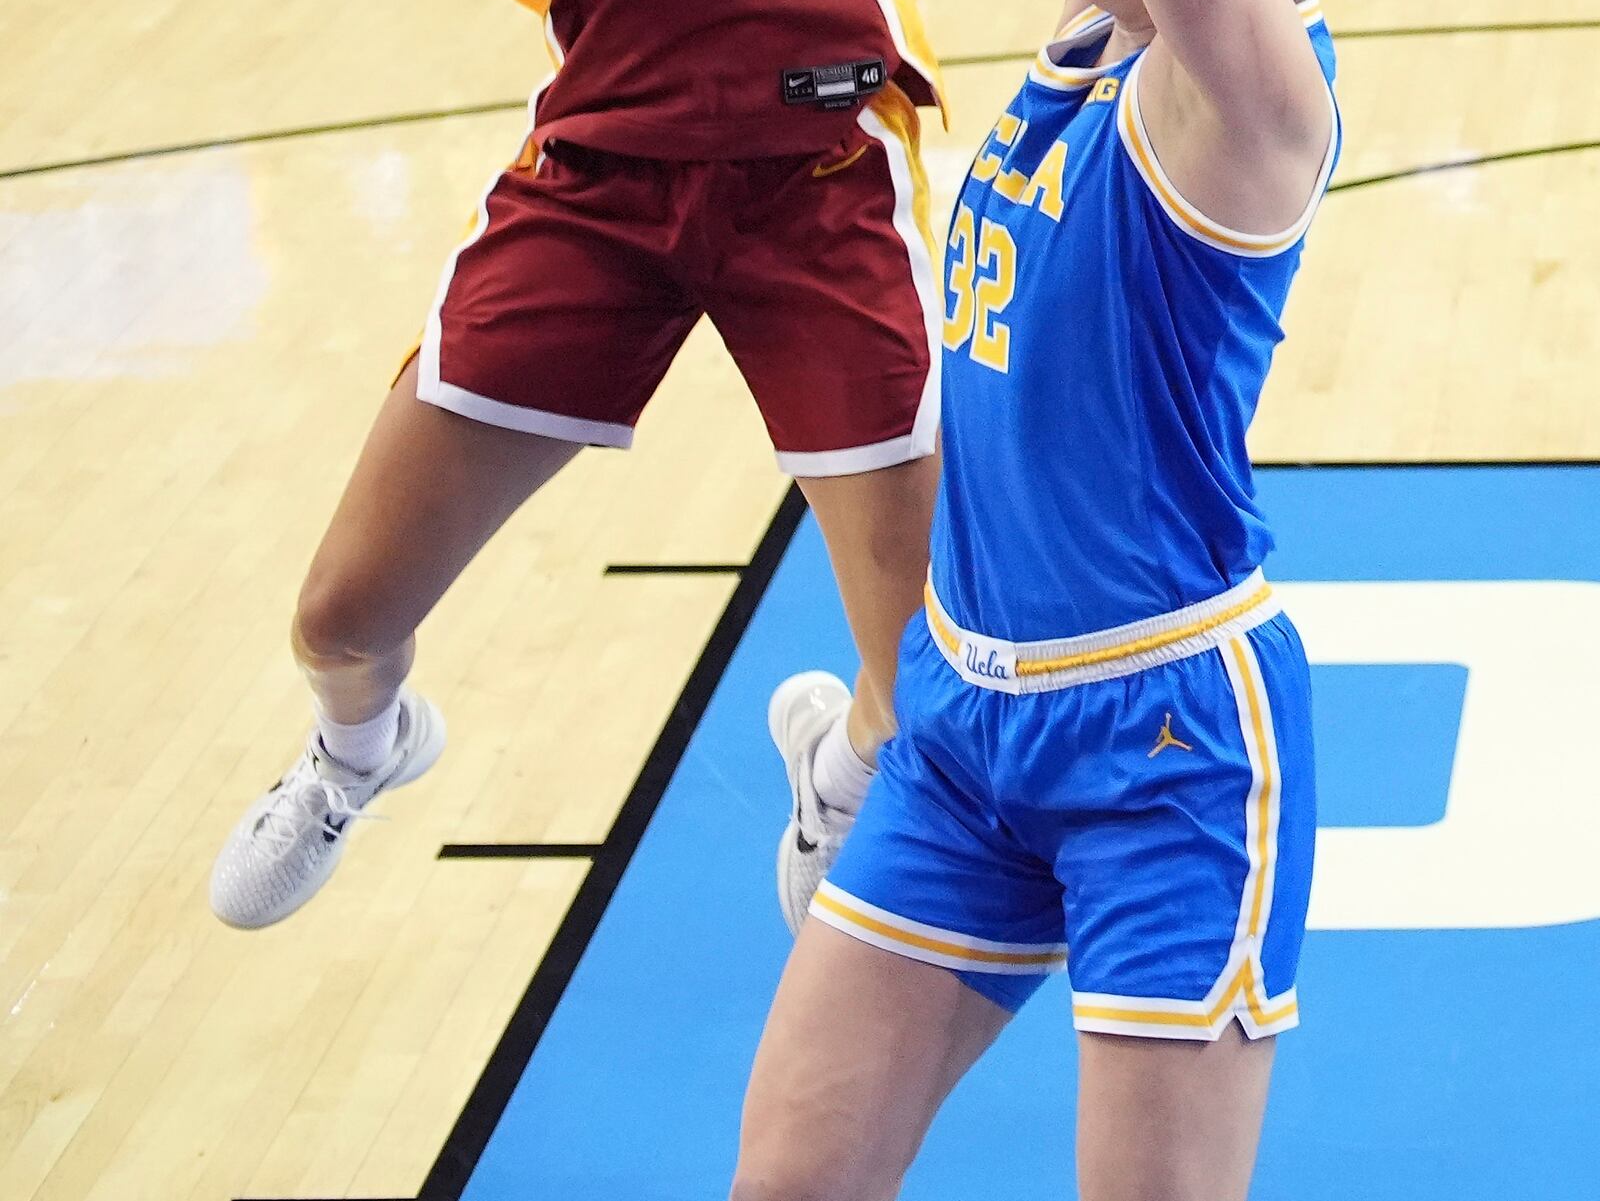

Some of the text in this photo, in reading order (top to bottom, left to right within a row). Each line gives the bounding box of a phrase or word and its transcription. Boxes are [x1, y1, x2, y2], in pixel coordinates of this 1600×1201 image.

[971, 112, 1069, 223] CLA
[942, 200, 1017, 375] 32
[966, 642, 1010, 680] Ucla
